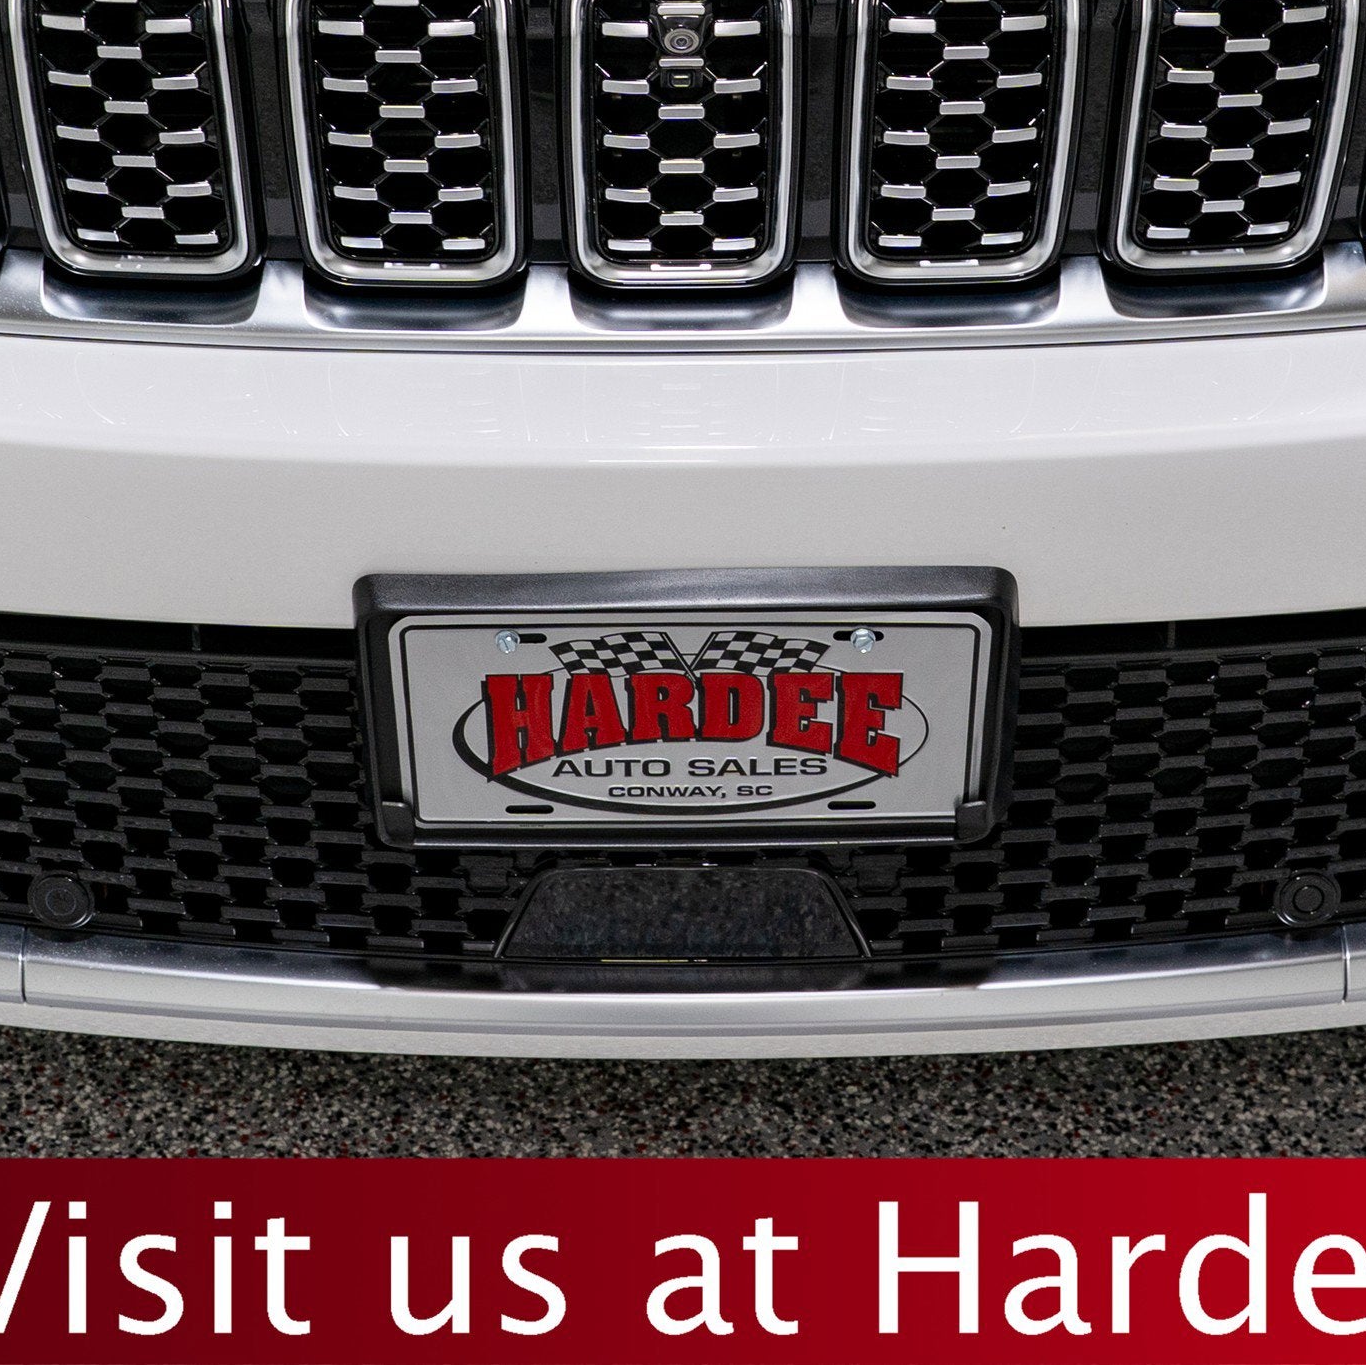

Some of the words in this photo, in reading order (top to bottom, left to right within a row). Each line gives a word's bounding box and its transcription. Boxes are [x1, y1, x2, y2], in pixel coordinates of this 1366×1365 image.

[483, 672, 904, 780] HARDEE
[551, 757, 673, 778] AUTO
[687, 756, 828, 777] SALES
[607, 784, 726, 799] CONWAY,
[736, 784, 774, 798] SC
